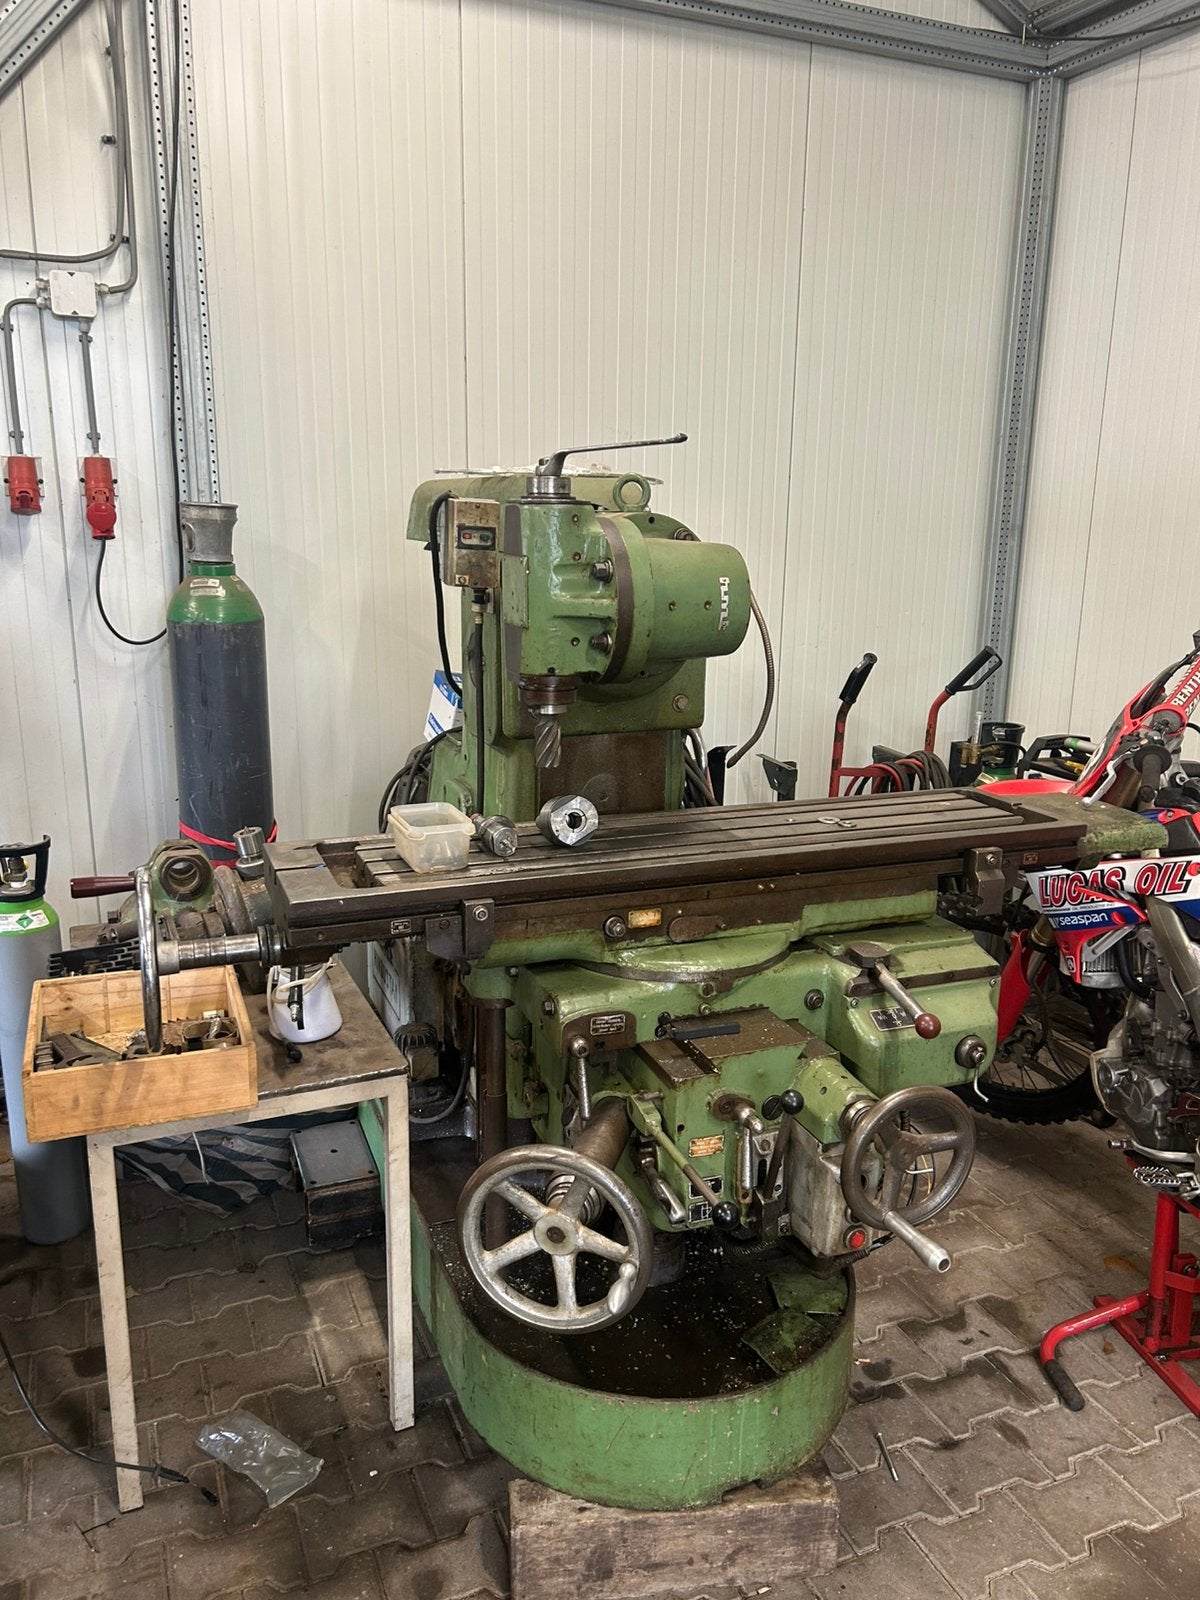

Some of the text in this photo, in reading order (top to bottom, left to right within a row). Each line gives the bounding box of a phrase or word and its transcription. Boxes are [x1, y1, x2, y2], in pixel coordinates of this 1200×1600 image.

[1170, 667, 1200, 706] RENTH
[1038, 861, 1193, 908] LUCAS OIL
[1060, 911, 1109, 925] seaspan
